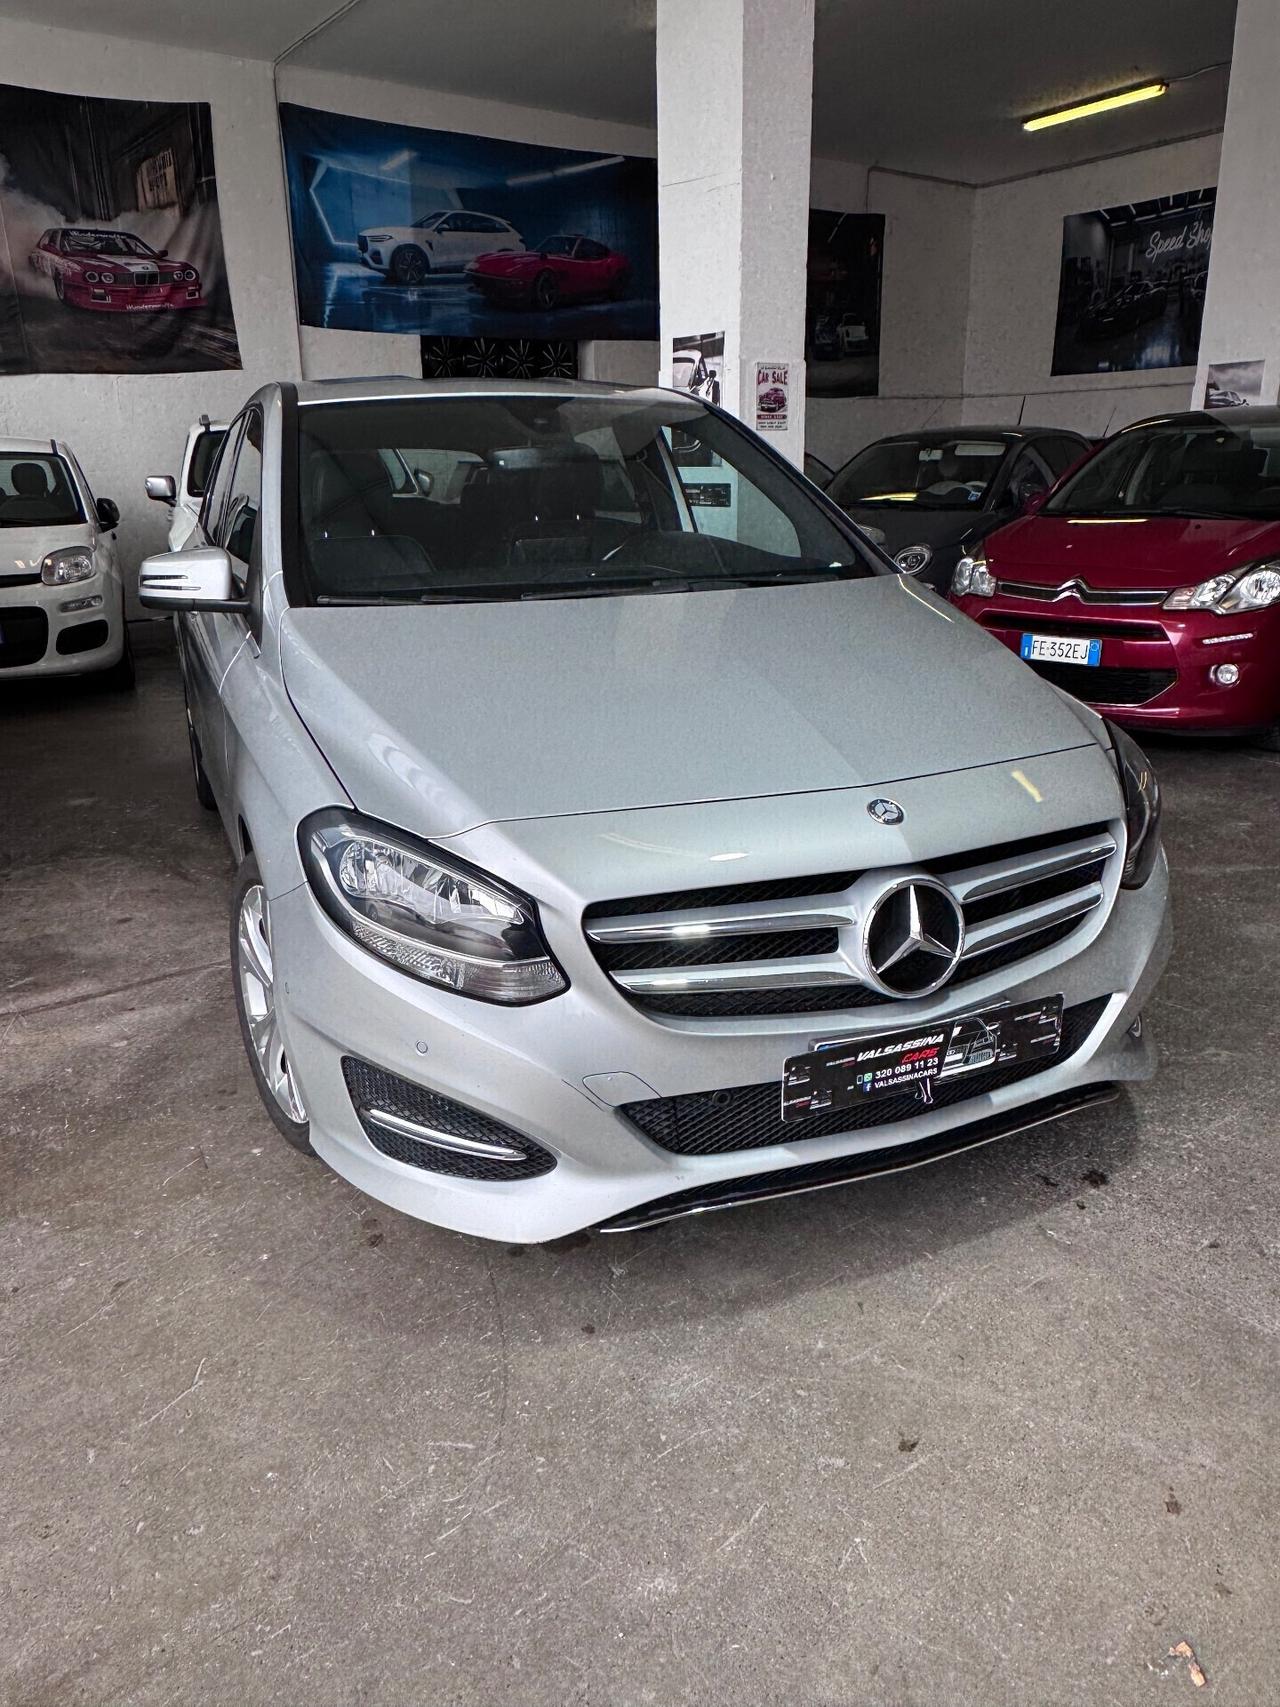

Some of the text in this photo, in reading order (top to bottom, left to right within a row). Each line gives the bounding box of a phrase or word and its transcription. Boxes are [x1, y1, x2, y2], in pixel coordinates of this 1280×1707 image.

[1145, 230, 1188, 264] Speed
[757, 369, 789, 386] CAR SALE
[856, 1033, 945, 1062] VALSASSINA
[901, 1046, 941, 1064] CARS
[874, 1067, 938, 1089] VALSASSINACARS
[875, 1057, 939, 1080] 320 089 11 23
